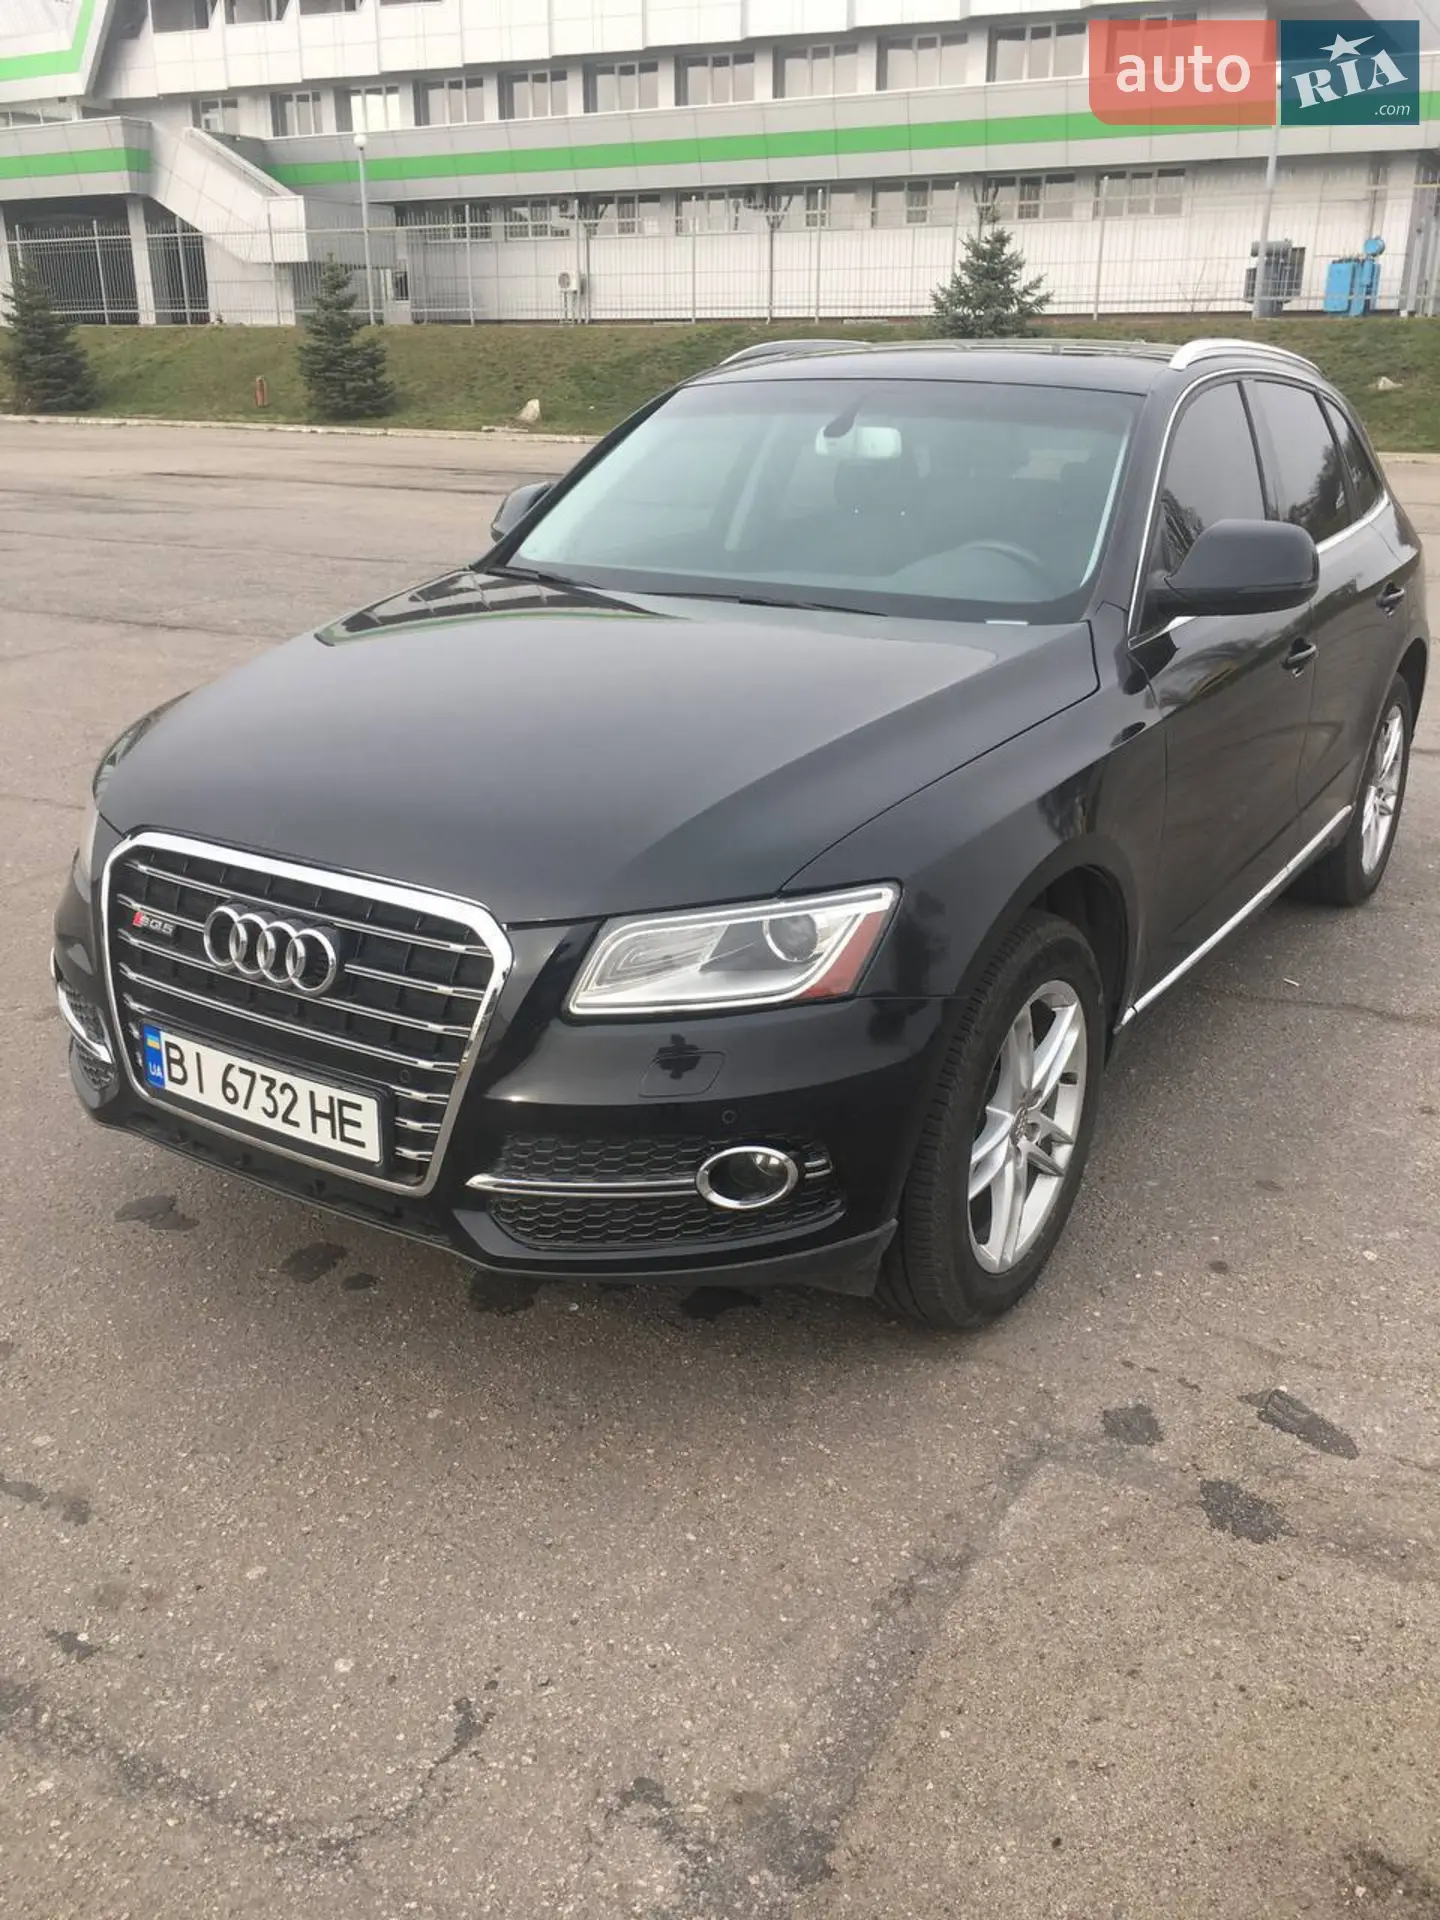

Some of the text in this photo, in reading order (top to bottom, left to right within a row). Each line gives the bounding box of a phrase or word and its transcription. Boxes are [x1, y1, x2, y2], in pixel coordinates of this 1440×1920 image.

[149, 1061, 164, 1078] UA
[221, 1063, 300, 1128] 6732
[309, 1090, 366, 1149] HE
